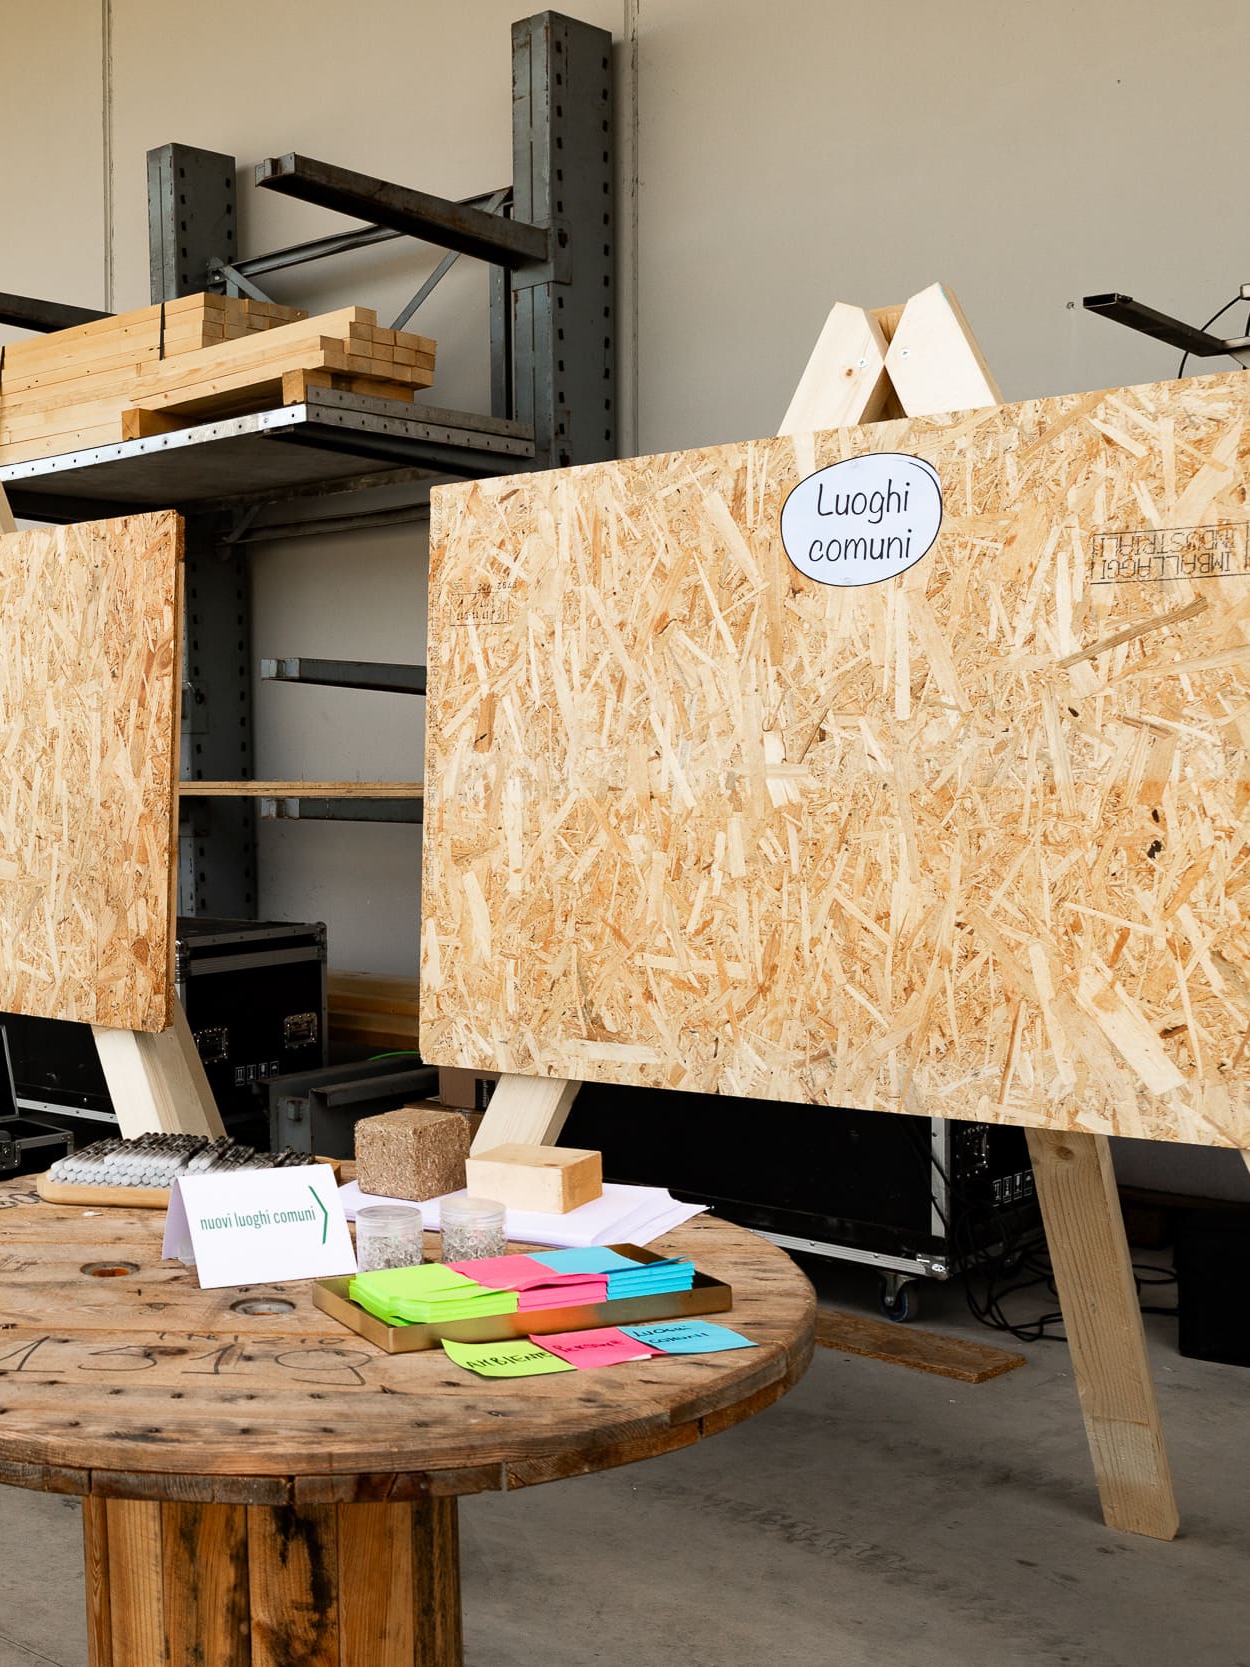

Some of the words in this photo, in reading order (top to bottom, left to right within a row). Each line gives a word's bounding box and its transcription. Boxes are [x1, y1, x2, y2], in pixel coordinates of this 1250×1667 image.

[816, 478, 911, 524] Luoghi
[808, 529, 912, 562] comuni
[1101, 552, 1230, 580] IMBALLAGGI
[200, 1213, 232, 1231] nuovi
[234, 1209, 271, 1229] luoghi
[274, 1205, 316, 1224] comuni
